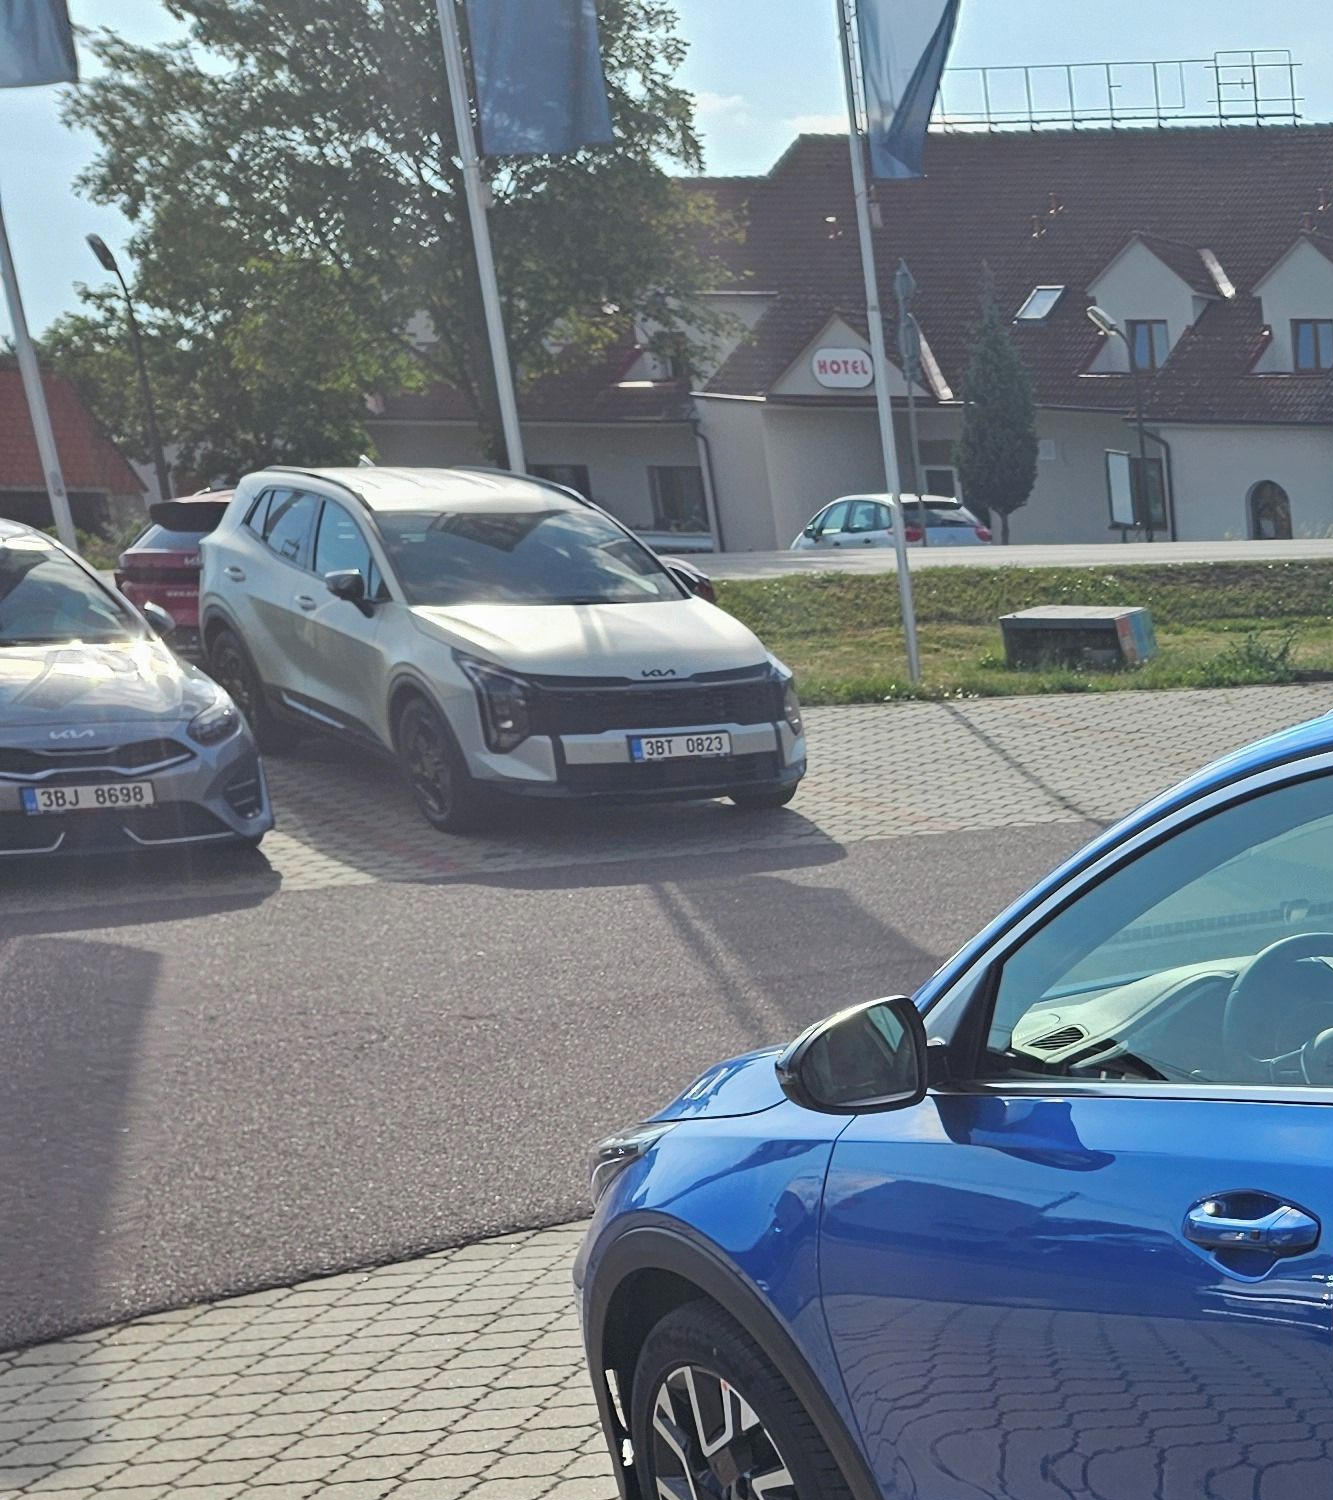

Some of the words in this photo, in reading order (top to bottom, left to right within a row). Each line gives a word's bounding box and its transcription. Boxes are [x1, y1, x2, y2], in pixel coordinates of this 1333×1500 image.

[817, 360, 868, 374] HOTEL
[641, 669, 676, 677] KIA
[49, 729, 95, 739] KIA
[645, 739, 673, 756] 3BT
[686, 736, 723, 753] 0823
[40, 789, 80, 808] 3BJ
[94, 785, 144, 805] 8698
